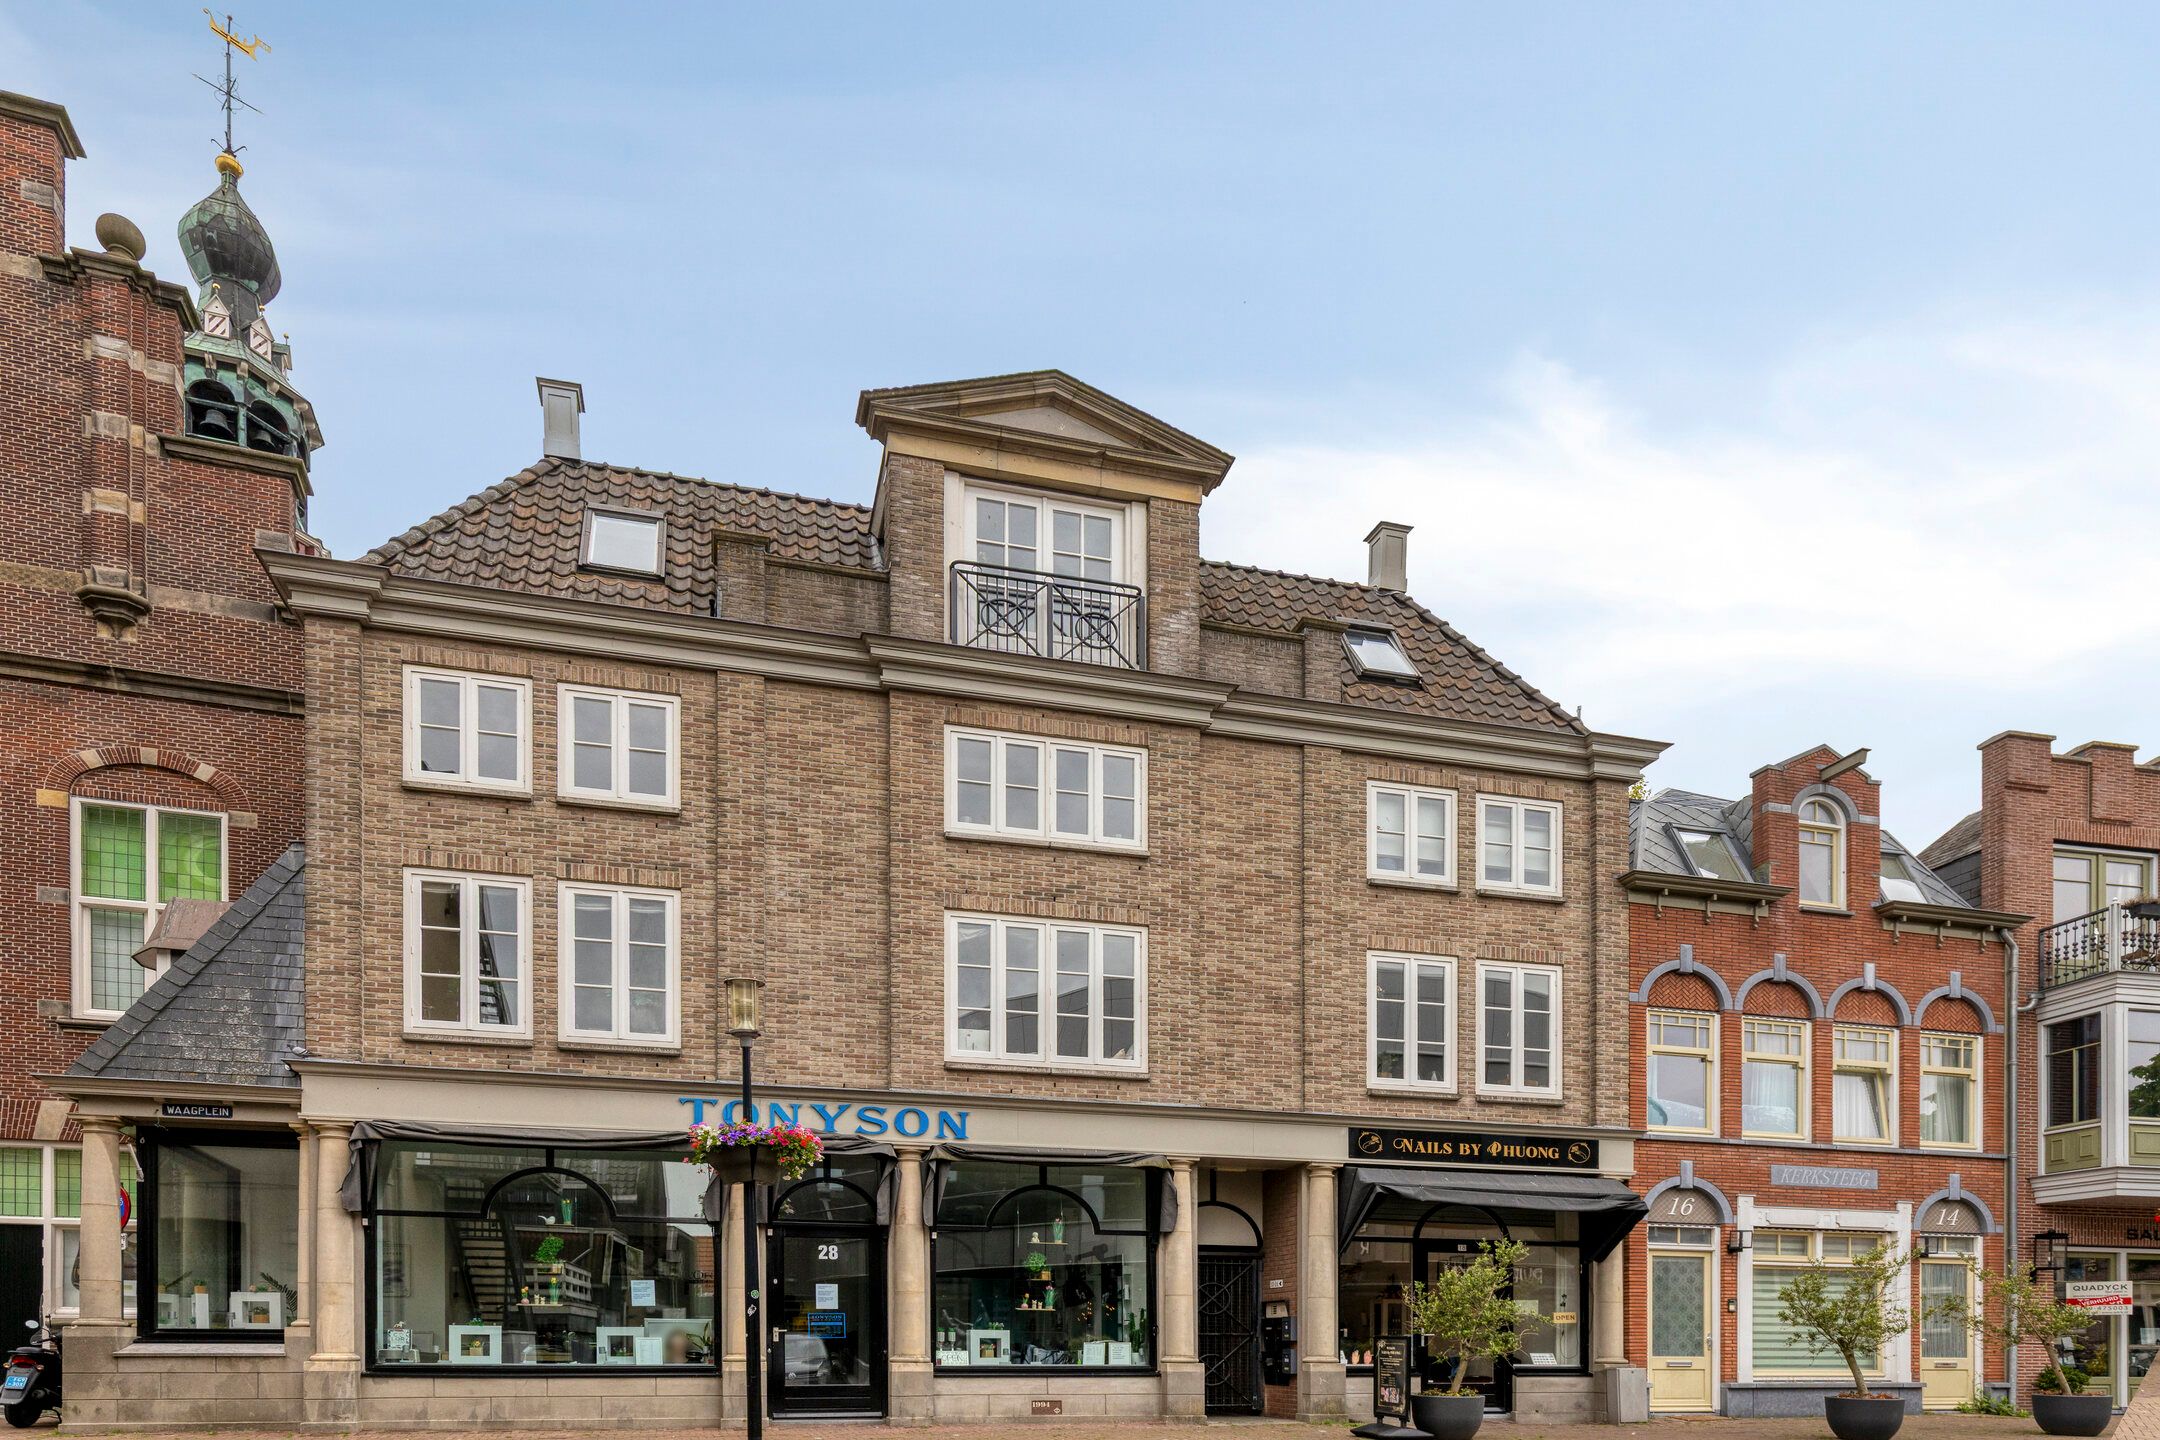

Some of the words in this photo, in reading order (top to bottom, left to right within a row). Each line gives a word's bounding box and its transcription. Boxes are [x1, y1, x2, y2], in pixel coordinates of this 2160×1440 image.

[167, 1105, 229, 1116] WAAGPLEIN
[678, 1097, 970, 1140] TONYSON
[1781, 1168, 1871, 1187] KERKSTEEG
[1667, 1197, 1695, 1216] 16
[1936, 1208, 1960, 1226] 14
[818, 1245, 839, 1260] 28
[2081, 1295, 2119, 1305] VERHUURD
